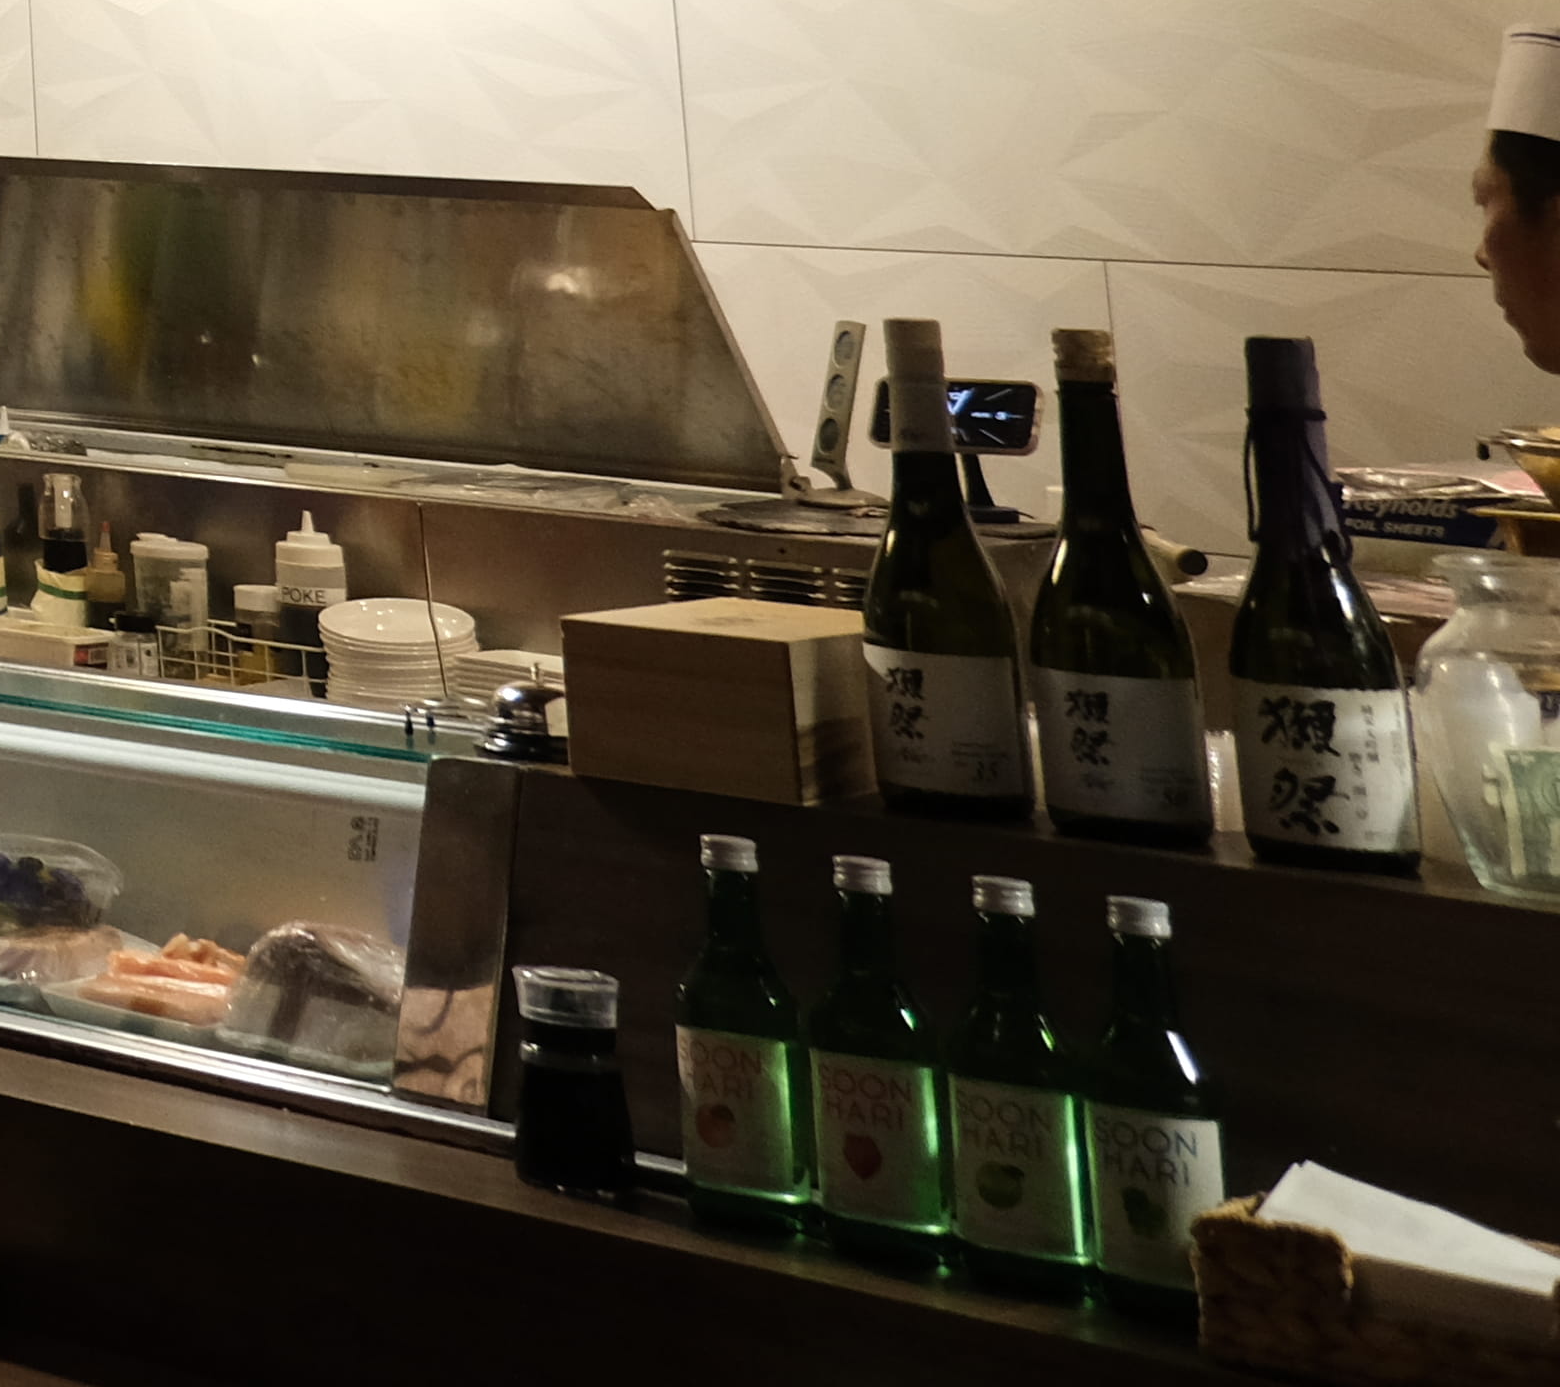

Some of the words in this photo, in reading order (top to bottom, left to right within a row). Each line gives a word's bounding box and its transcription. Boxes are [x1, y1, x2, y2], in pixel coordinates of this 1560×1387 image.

[1383, 520, 1446, 539] SHEETS
[281, 586, 327, 604] POKE
[821, 1065, 913, 1102] SOON
[825, 1099, 905, 1131] HARI
[957, 1090, 1052, 1131] SOON
[965, 1128, 1044, 1158] HARI
[1095, 1117, 1197, 1157] SOON
[1104, 1150, 1191, 1186] HARI
